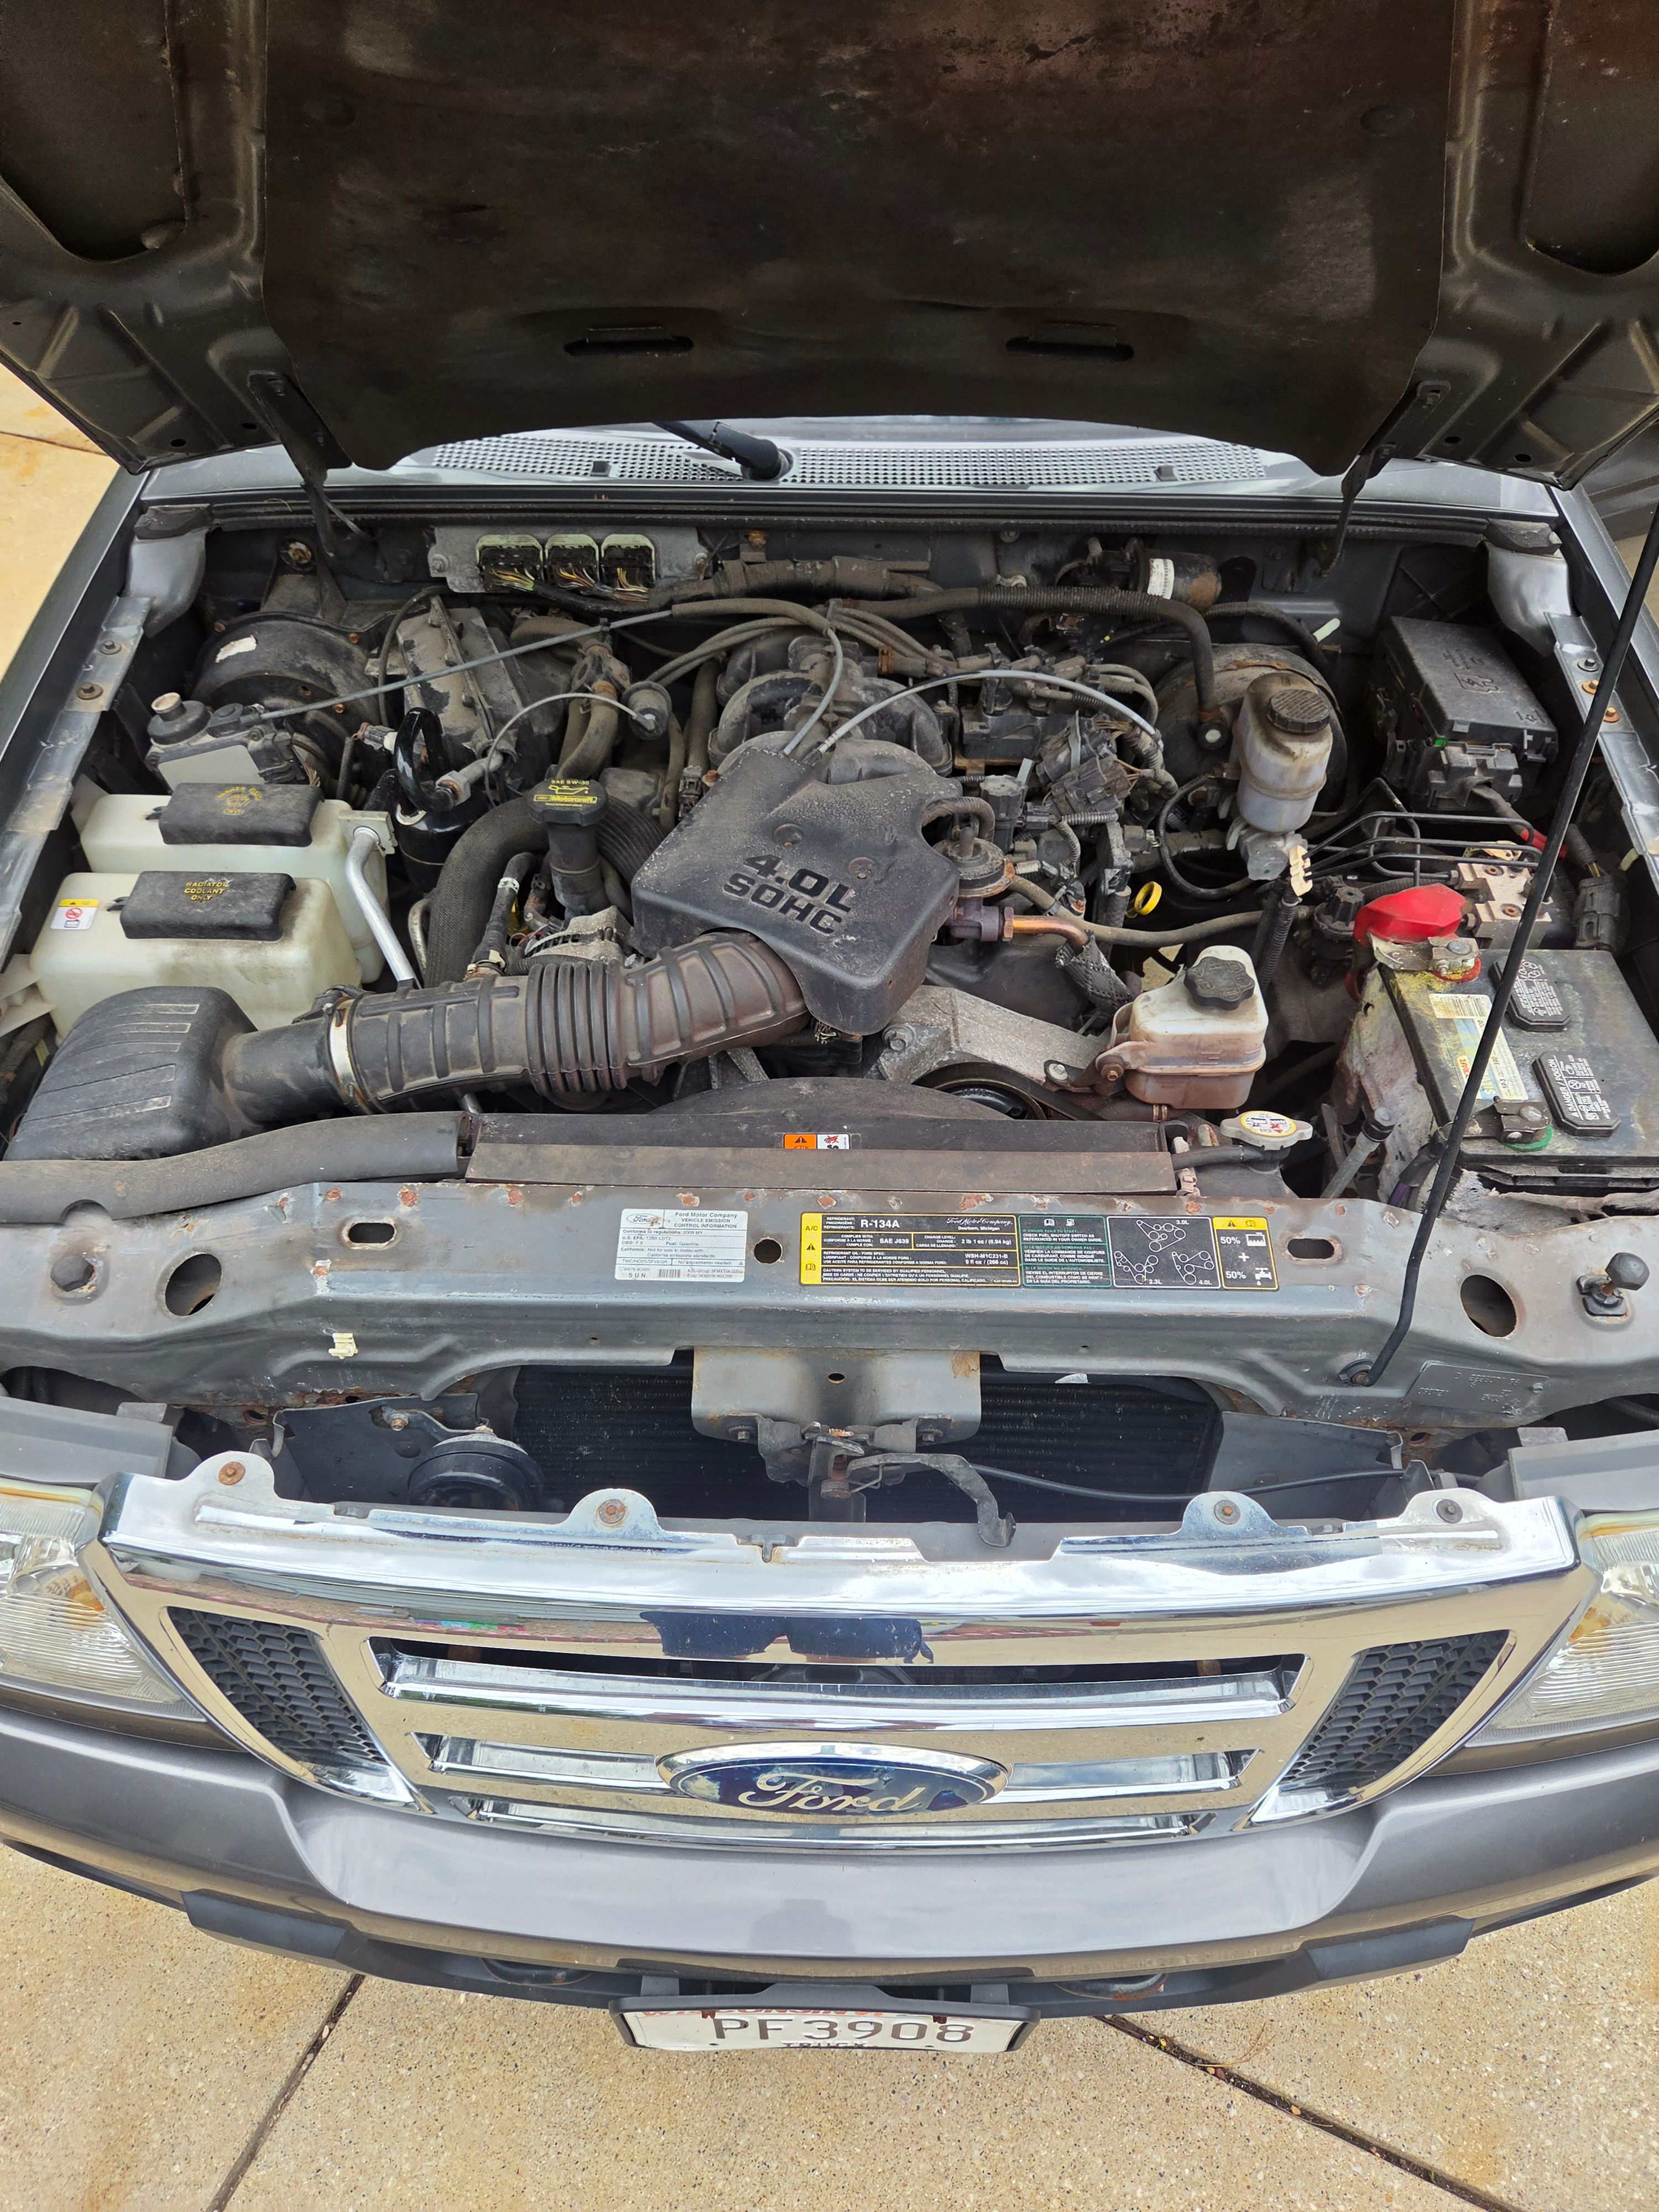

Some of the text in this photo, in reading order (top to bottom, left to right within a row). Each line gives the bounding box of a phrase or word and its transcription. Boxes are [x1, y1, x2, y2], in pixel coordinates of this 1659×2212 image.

[743, 854, 852, 913] 4.0L
[723, 873, 842, 935] SOHC
[1548, 1059, 1563, 1082] POISON
[1559, 1086, 1577, 1112] DANGER
[860, 1219, 900, 1228] R-134A
[960, 1217, 981, 1225] Motor
[738, 1772, 926, 1812] Ford
[712, 2018, 974, 2043] PF3908
